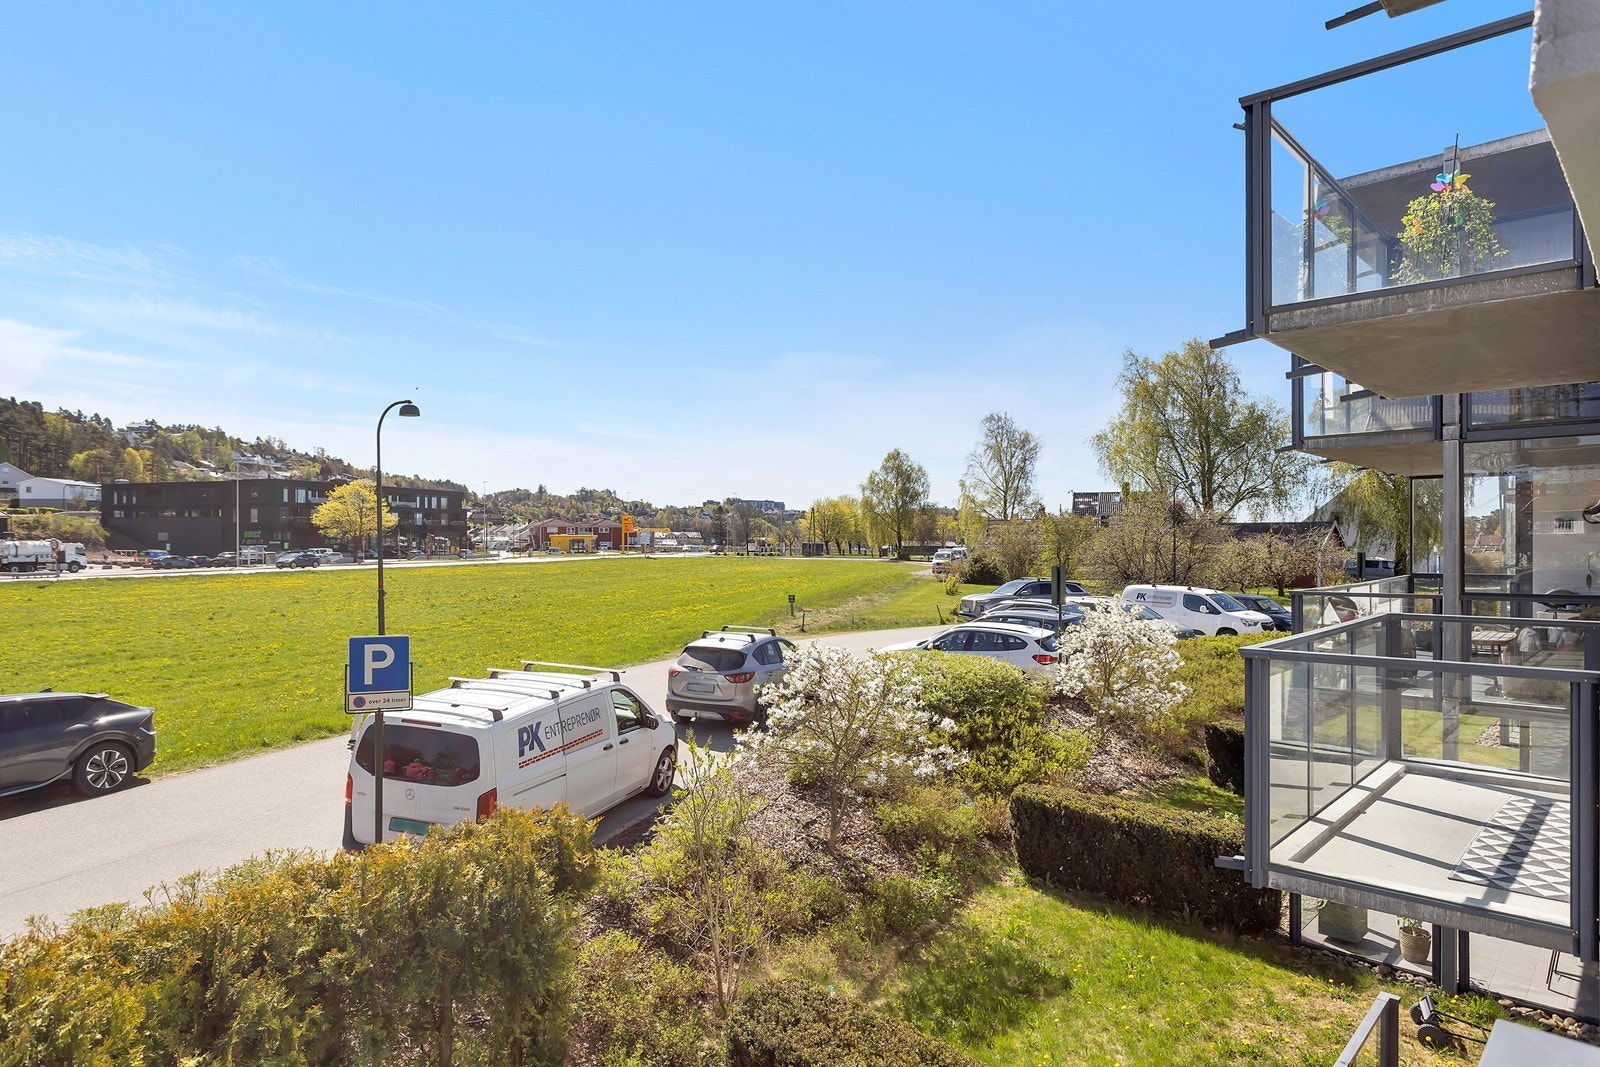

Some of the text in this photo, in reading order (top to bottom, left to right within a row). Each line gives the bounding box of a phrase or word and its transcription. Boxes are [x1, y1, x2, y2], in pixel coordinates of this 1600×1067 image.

[1136, 592, 1147, 601] PK
[364, 643, 395, 685] P
[391, 696, 407, 704] timer
[517, 707, 602, 758] PK ENTREPRENØR
